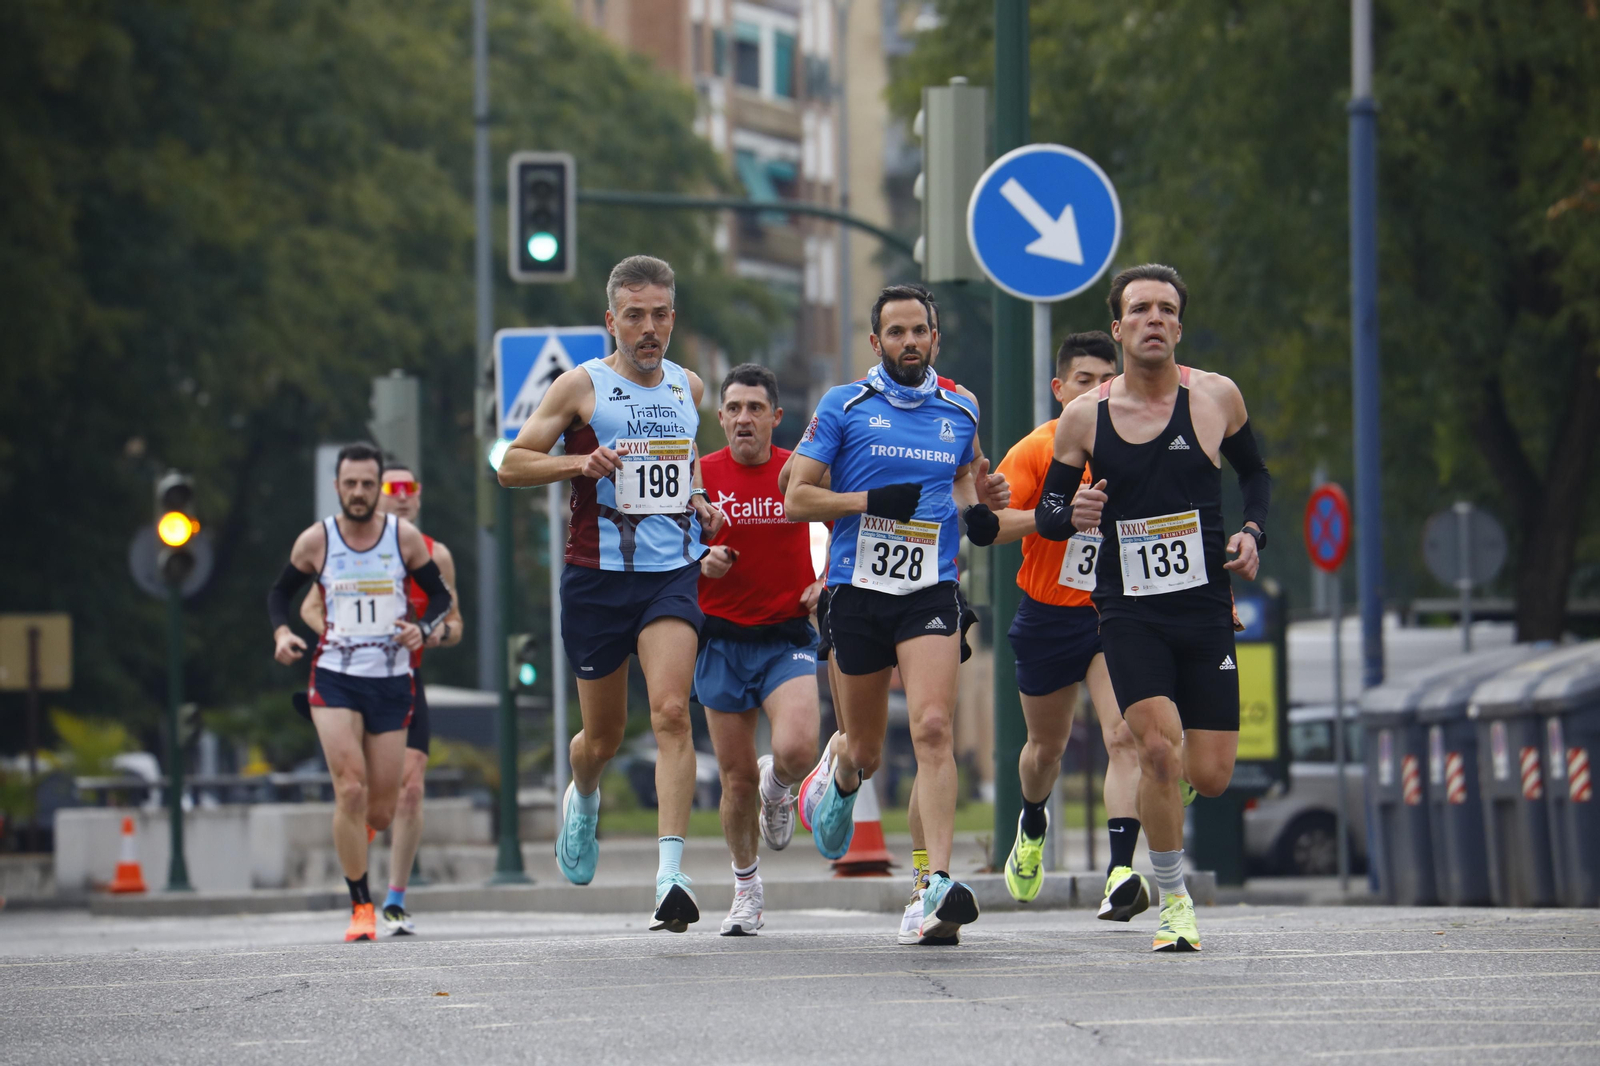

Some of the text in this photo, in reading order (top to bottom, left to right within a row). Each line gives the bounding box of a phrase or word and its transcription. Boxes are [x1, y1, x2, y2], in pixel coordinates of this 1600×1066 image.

[624, 404, 676, 419] Triatlon
[620, 442, 648, 454] XXXIX
[870, 444, 956, 465] TROTASIERRA
[636, 464, 679, 498] 198
[864, 517, 895, 532] XXXIX
[1120, 522, 1147, 536] XXXIX
[1162, 528, 1198, 538] TRINITARIOS
[872, 542, 924, 582] 328
[1137, 540, 1189, 579] 133
[354, 599, 375, 623] 11
